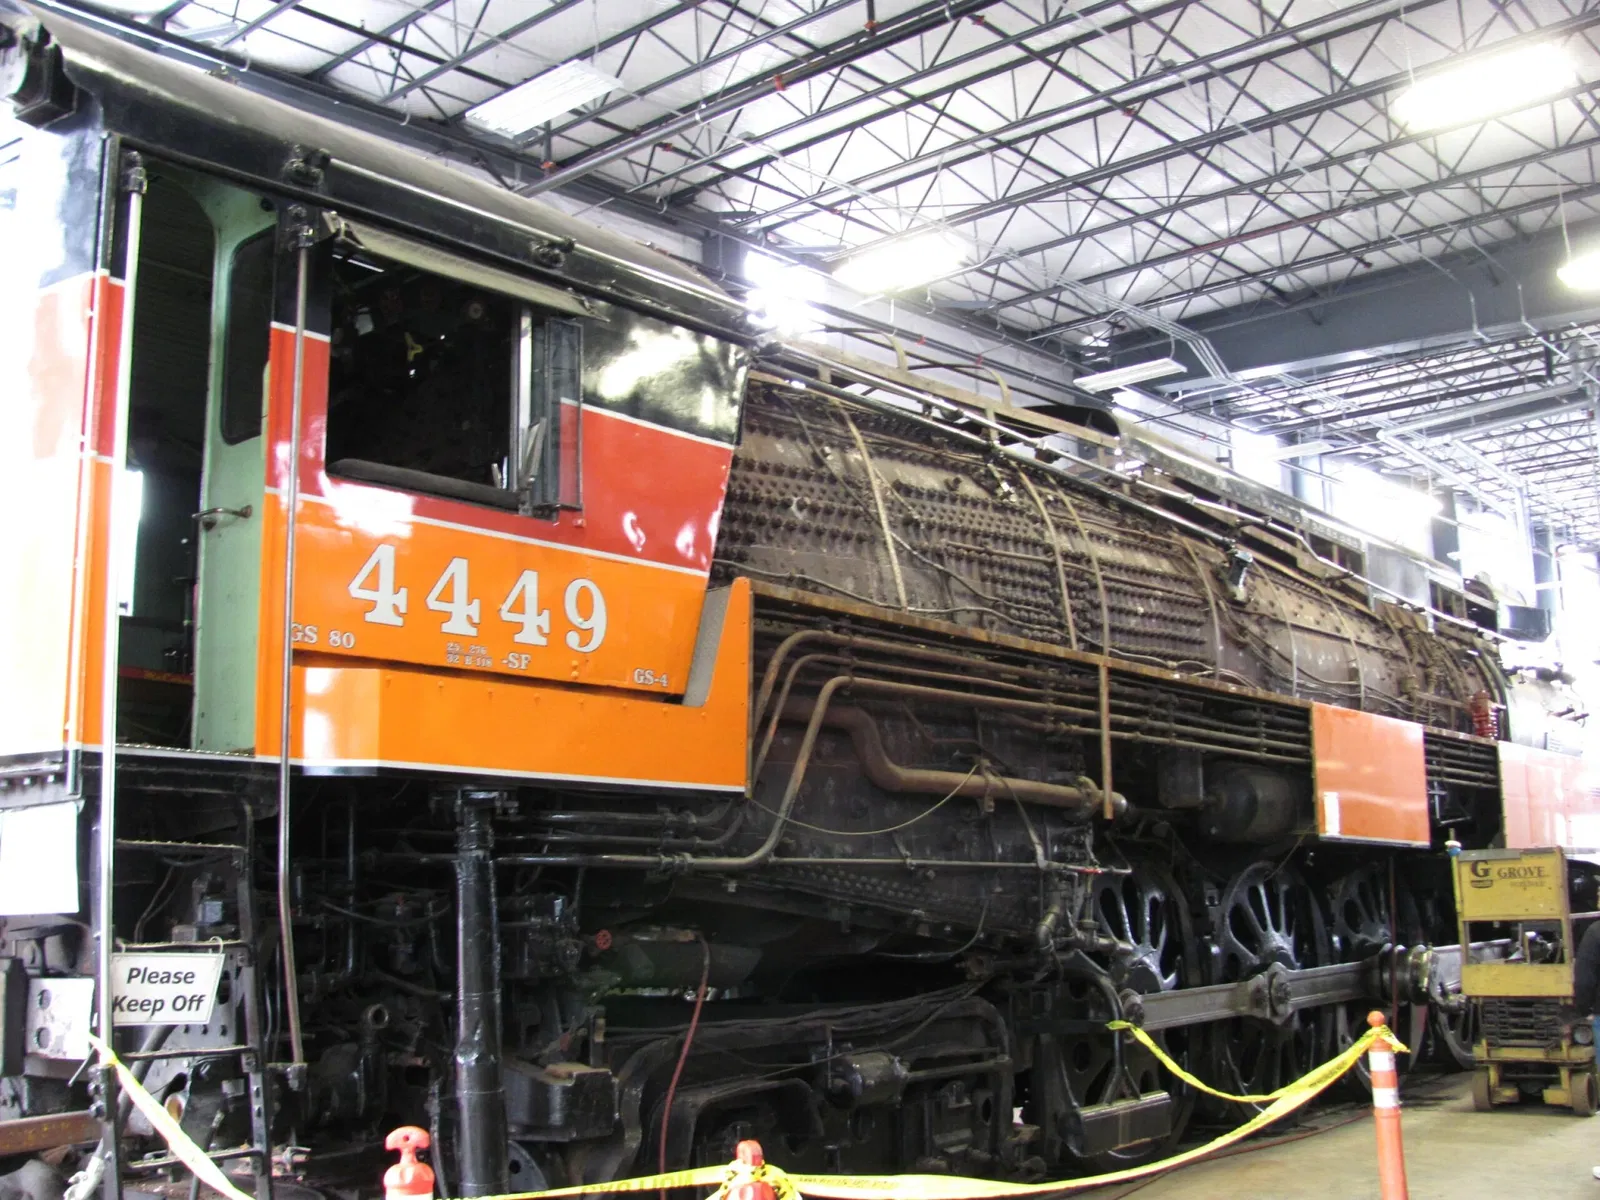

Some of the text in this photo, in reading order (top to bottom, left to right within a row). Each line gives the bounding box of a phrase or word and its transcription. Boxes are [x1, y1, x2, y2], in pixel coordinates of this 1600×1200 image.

[347, 543, 608, 653] 4449
[291, 622, 355, 648] GS 80
[634, 668, 668, 687] GS-4
[1471, 859, 1491, 877] G
[1497, 866, 1545, 878] GROVE
[126, 967, 195, 984] Please
[112, 994, 206, 1017] Keep Off
